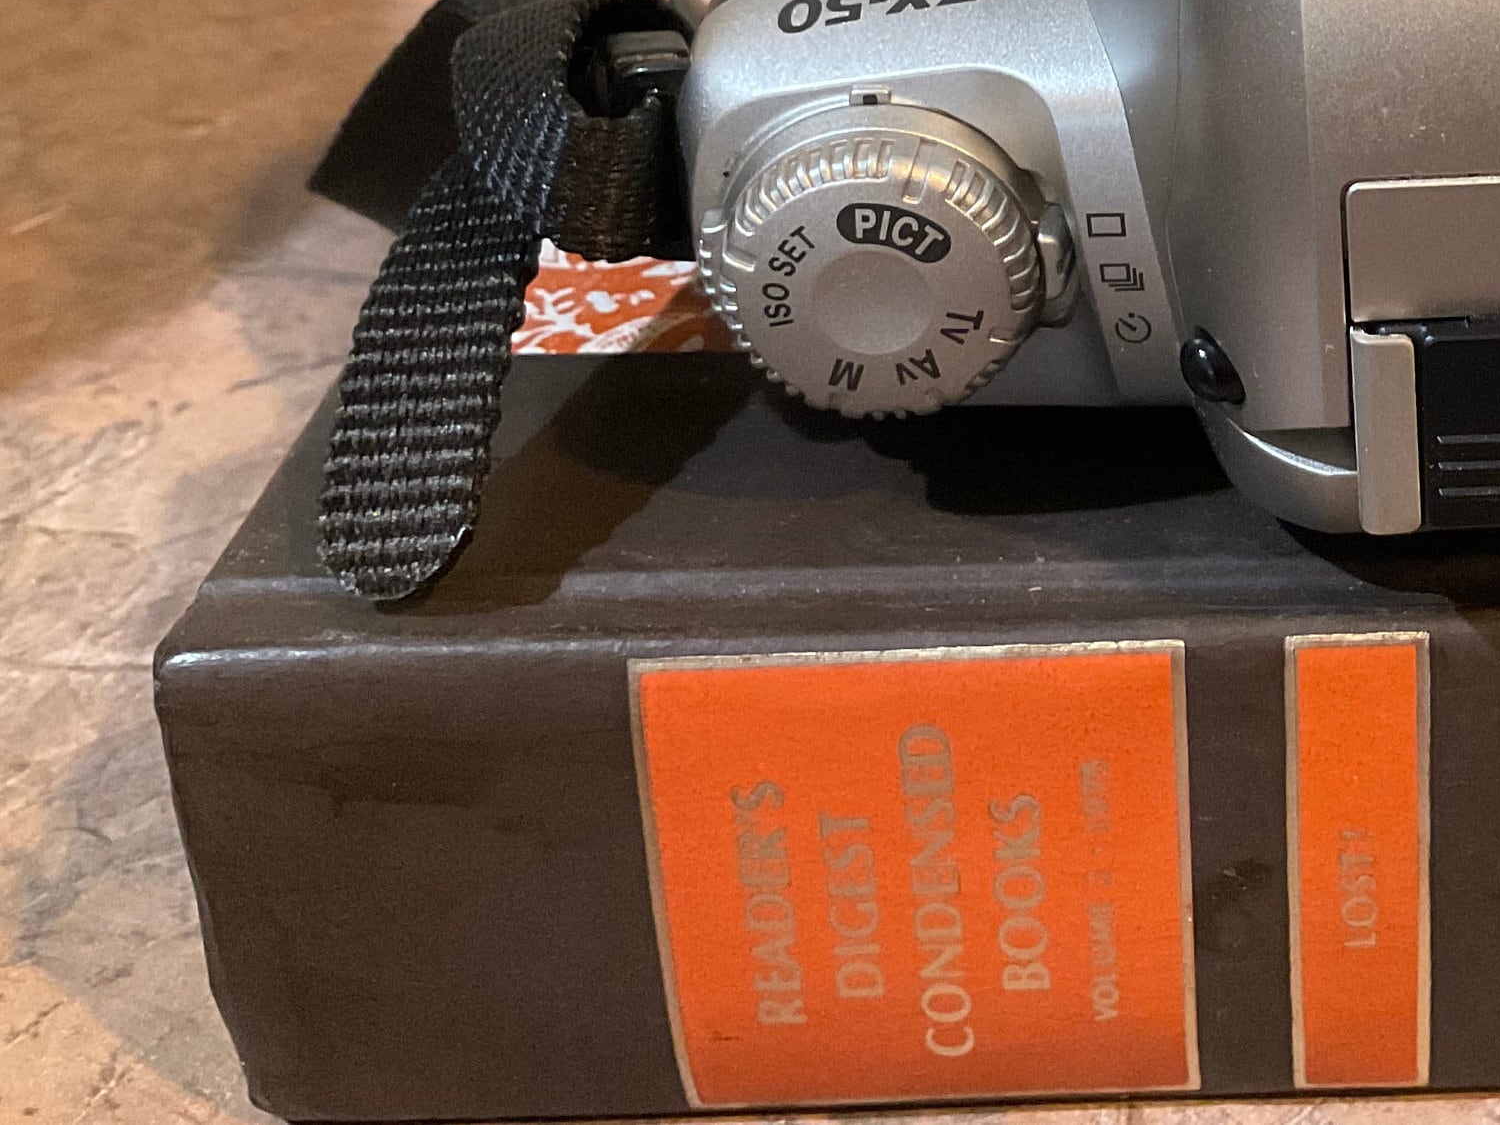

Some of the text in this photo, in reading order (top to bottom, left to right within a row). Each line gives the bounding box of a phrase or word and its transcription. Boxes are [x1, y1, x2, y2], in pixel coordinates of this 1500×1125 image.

[762, 225, 816, 328] ISO SET
[854, 208, 944, 256] PICT
[828, 358, 865, 392] M
[730, 778, 807, 1027] READER'S
[819, 812, 885, 1001] DIGEST
[897, 722, 975, 1057] CONDENSED
[989, 792, 1051, 991] BOOKS
